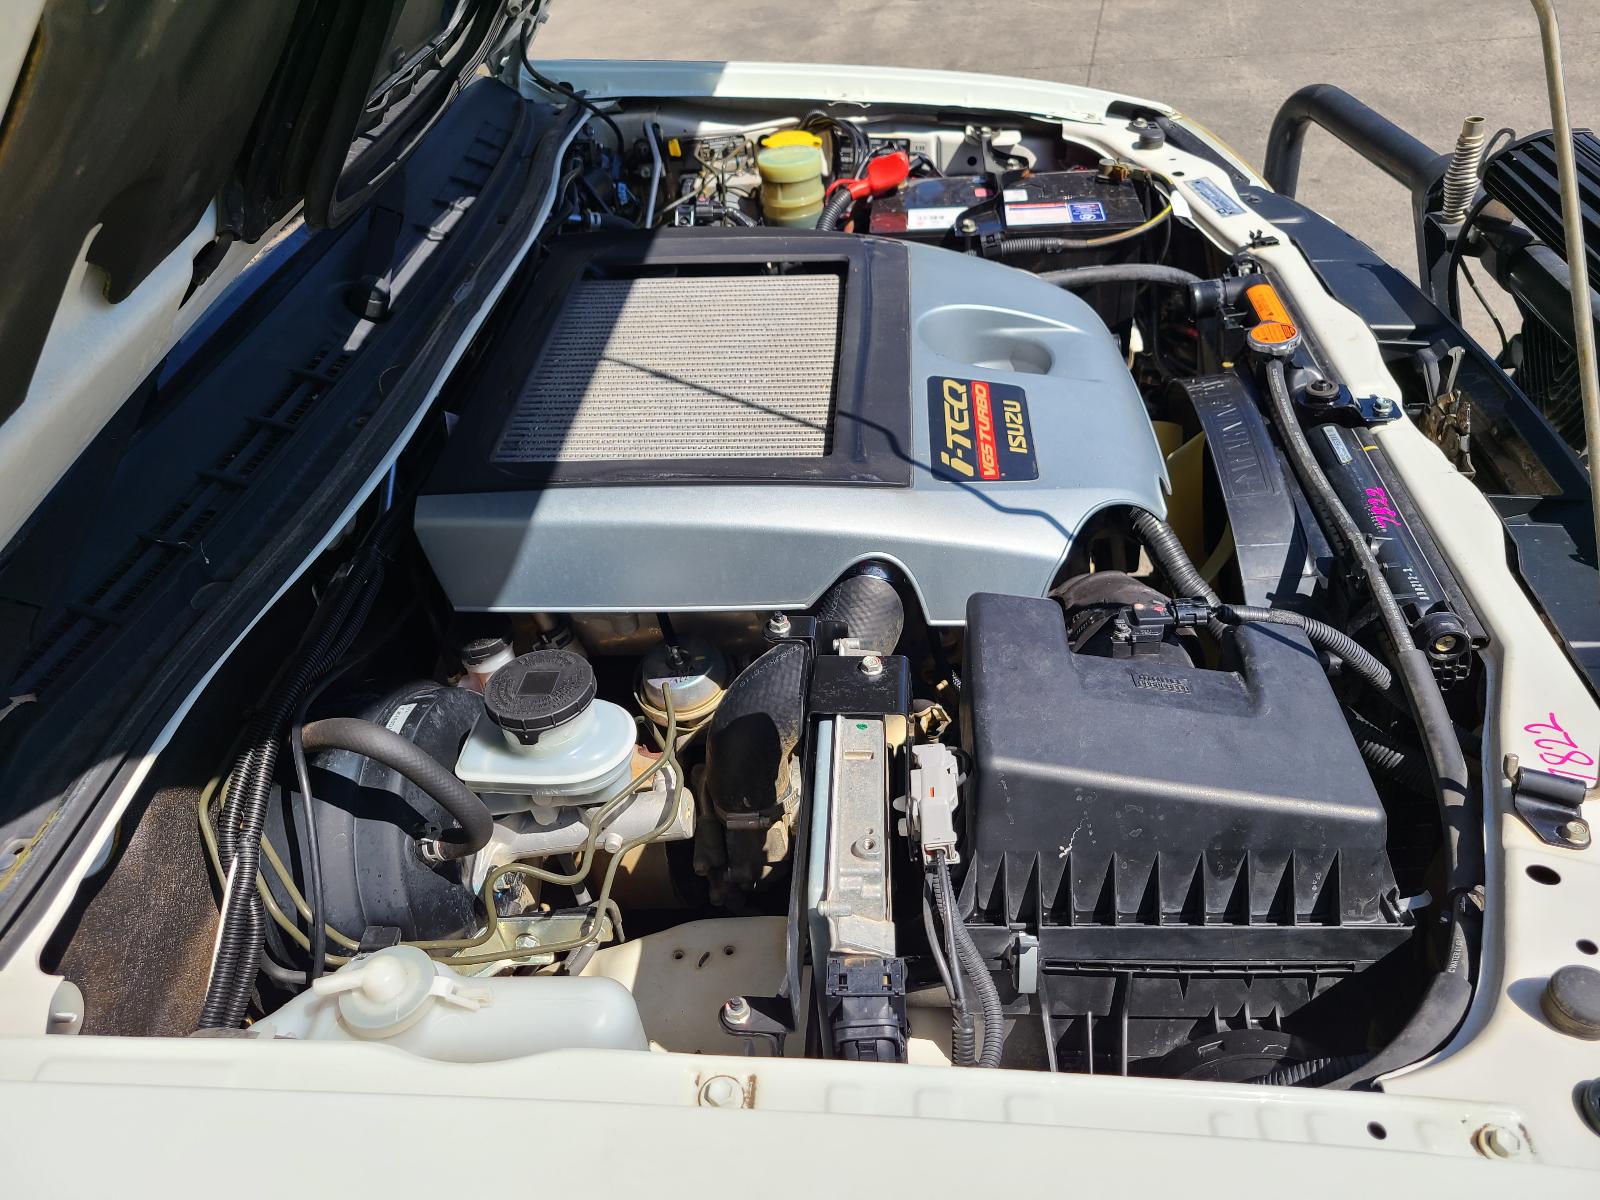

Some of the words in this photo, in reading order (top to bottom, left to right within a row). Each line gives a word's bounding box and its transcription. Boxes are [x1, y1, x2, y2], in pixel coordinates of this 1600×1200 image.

[974, 383, 992, 441] TURBO
[1003, 399, 1028, 454] ISUZU
[980, 442, 996, 477] VGS
